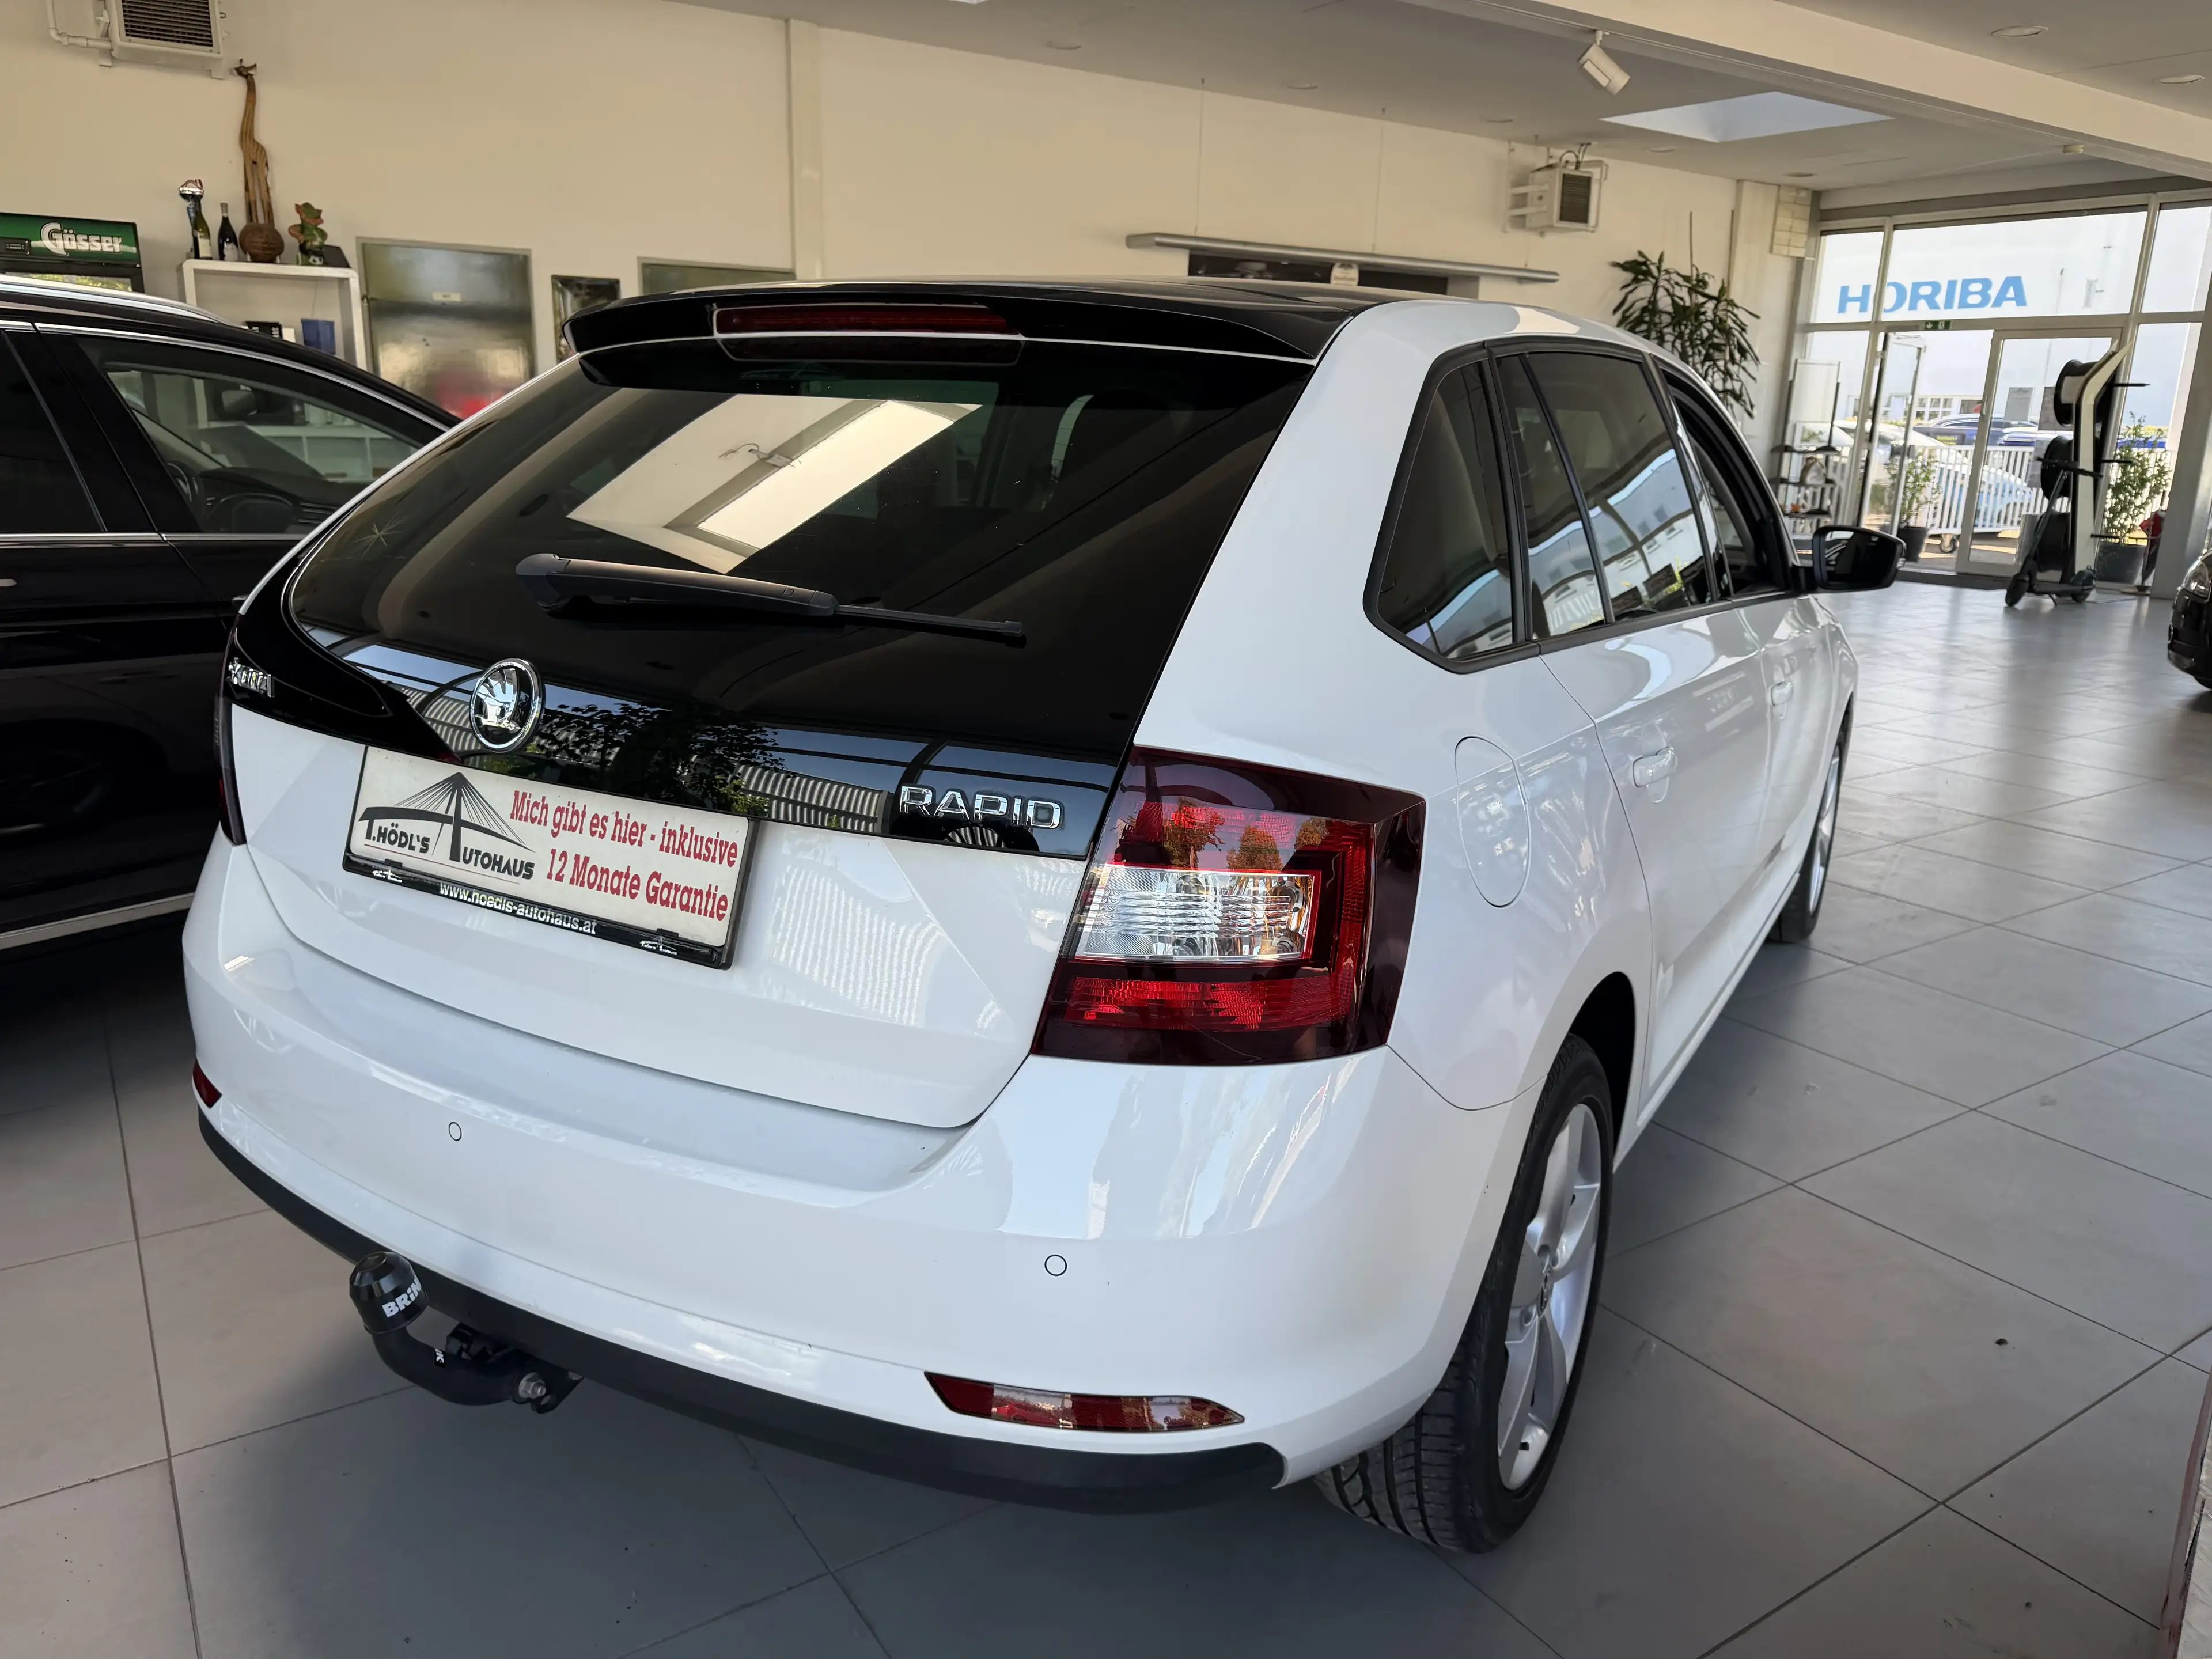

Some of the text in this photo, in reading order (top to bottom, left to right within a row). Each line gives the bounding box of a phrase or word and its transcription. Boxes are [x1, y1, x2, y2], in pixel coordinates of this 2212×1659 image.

[41, 222, 123, 256] Gösser
[1838, 275, 2028, 314] HORIBA
[899, 785, 1062, 828] RAPID
[510, 790, 550, 826] Mich
[551, 801, 587, 838] gibt
[589, 812, 609, 840] es
[611, 810, 647, 847] hier
[658, 821, 738, 868] inklusive
[547, 848, 729, 921] 12 Monate Garantie
